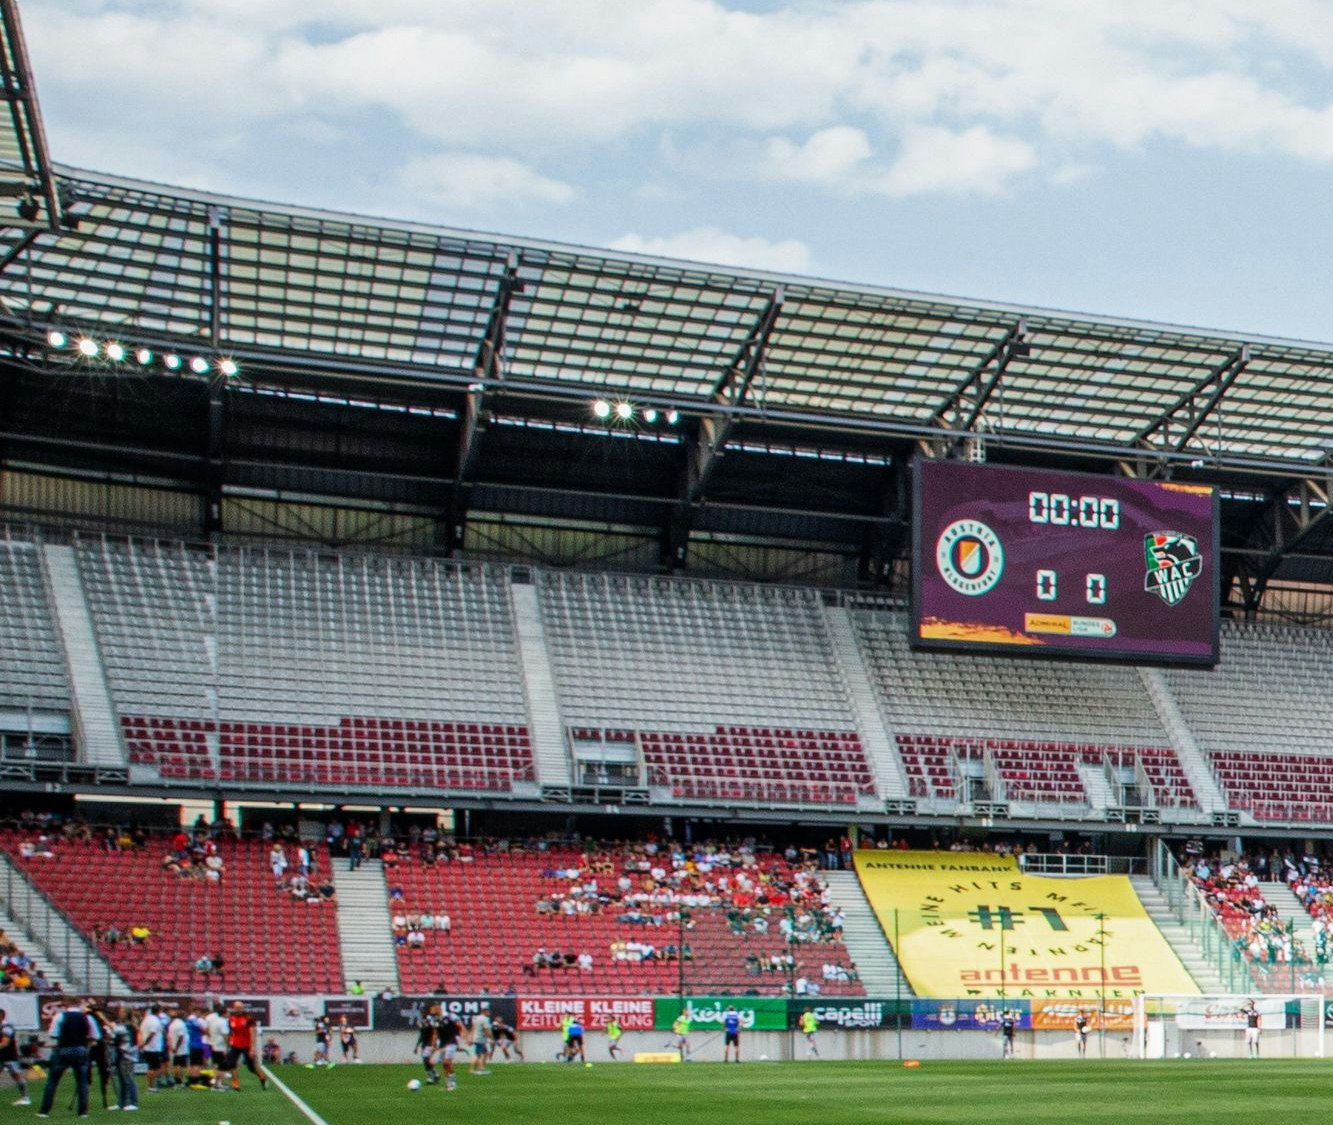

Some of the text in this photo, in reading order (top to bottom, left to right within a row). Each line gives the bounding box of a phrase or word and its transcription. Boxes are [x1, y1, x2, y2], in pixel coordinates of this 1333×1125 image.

[1029, 491, 1120, 530] 00:00
[944, 523, 995, 547] AUSTRIA
[1153, 561, 1194, 585] WAC
[1036, 569, 1106, 604] 0 0
[866, 862, 1013, 872] ANTENNE FANBANK
[949, 881, 1022, 894] HITS
[967, 904, 1070, 931] #1
[960, 963, 1142, 981] antenne
[521, 1001, 652, 1013] KLEINE KLEINE
[685, 1000, 755, 1028] kelg
[813, 1002, 882, 1025] capelli
[522, 1014, 585, 1027] ZEITUG
[590, 1014, 653, 1027] ZETUNG
